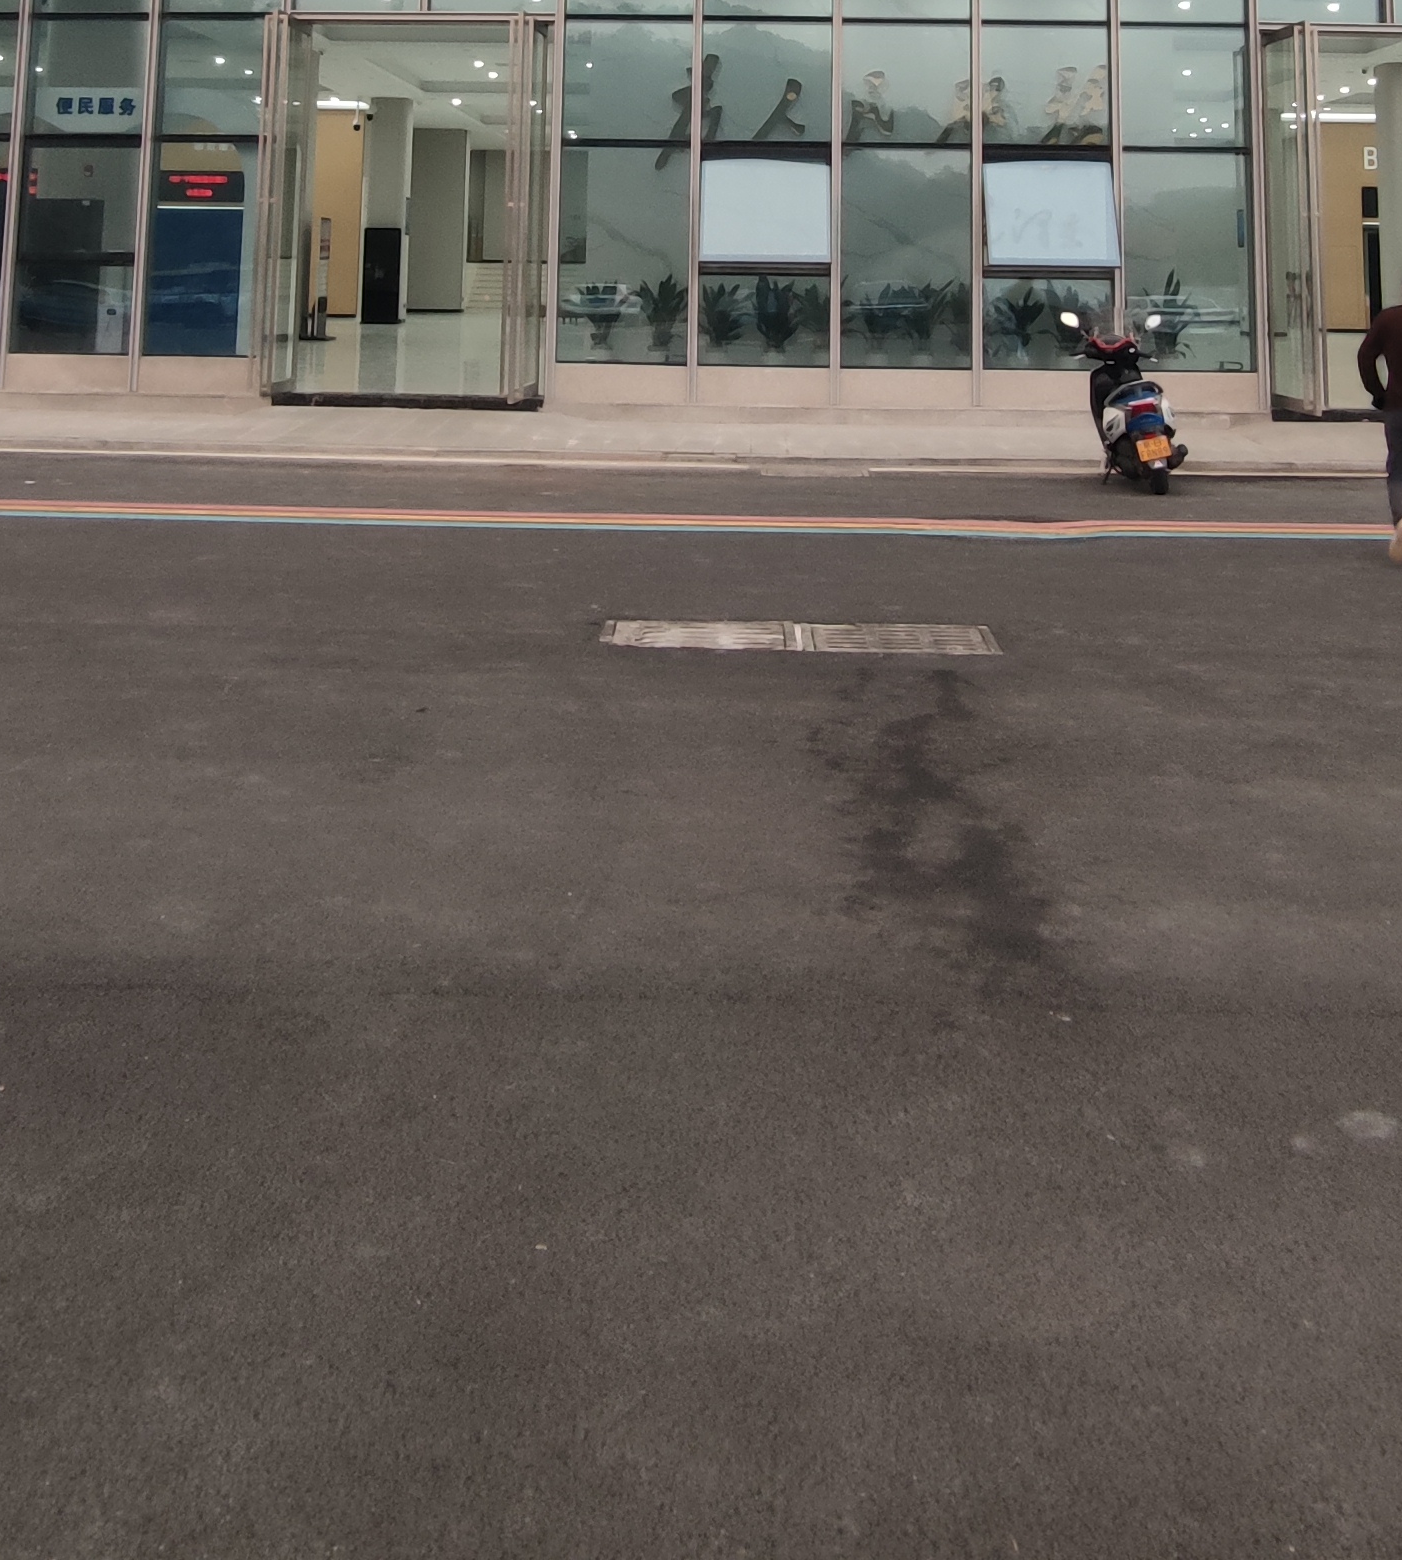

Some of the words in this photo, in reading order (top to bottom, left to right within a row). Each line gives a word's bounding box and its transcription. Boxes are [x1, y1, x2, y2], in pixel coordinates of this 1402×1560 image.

[56, 96, 136, 116] 便民服务
[1363, 146, 1378, 170] B
